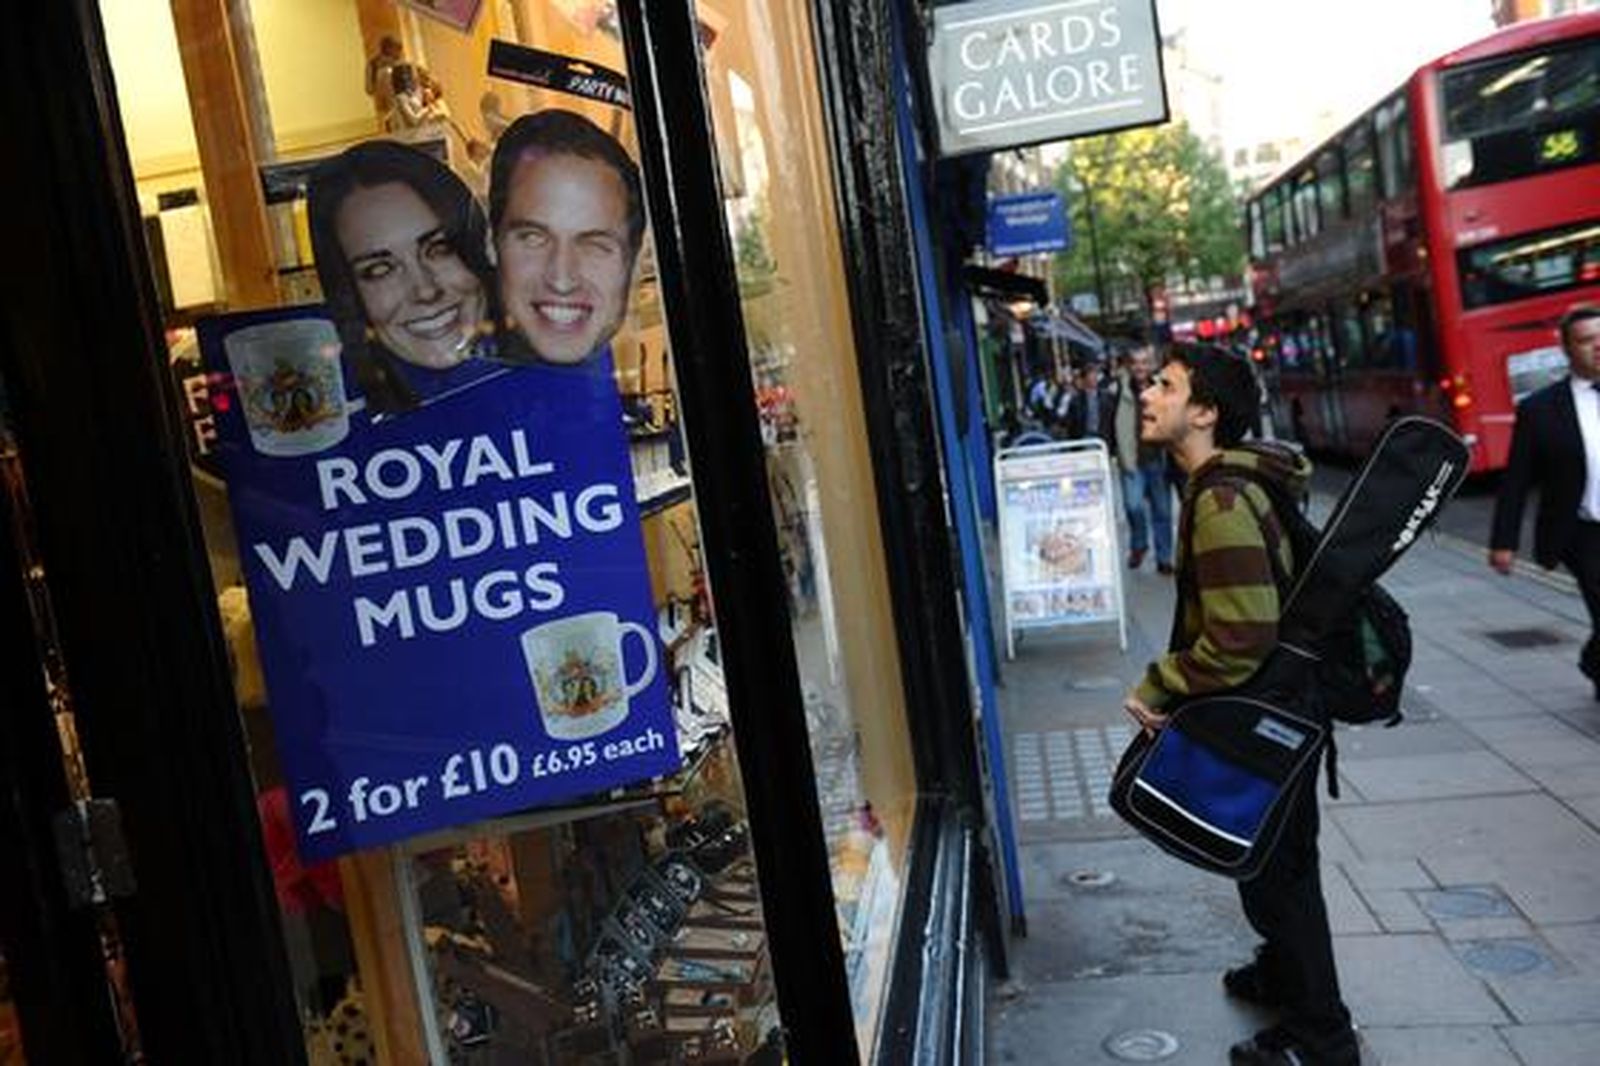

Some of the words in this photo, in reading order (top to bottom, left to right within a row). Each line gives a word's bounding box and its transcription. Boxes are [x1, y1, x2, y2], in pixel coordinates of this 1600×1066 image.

[960, 6, 1121, 71] CARDS
[567, 75, 615, 100] PARTY
[953, 53, 1144, 120] GALORE
[316, 429, 555, 510] ROYAL
[254, 483, 624, 591] WEDDING
[353, 562, 566, 647] MUGS
[300, 789, 337, 836] 2
[348, 772, 429, 822] for
[440, 743, 520, 801] £10
[532, 740, 597, 779] £6.95
[602, 729, 665, 763] each
